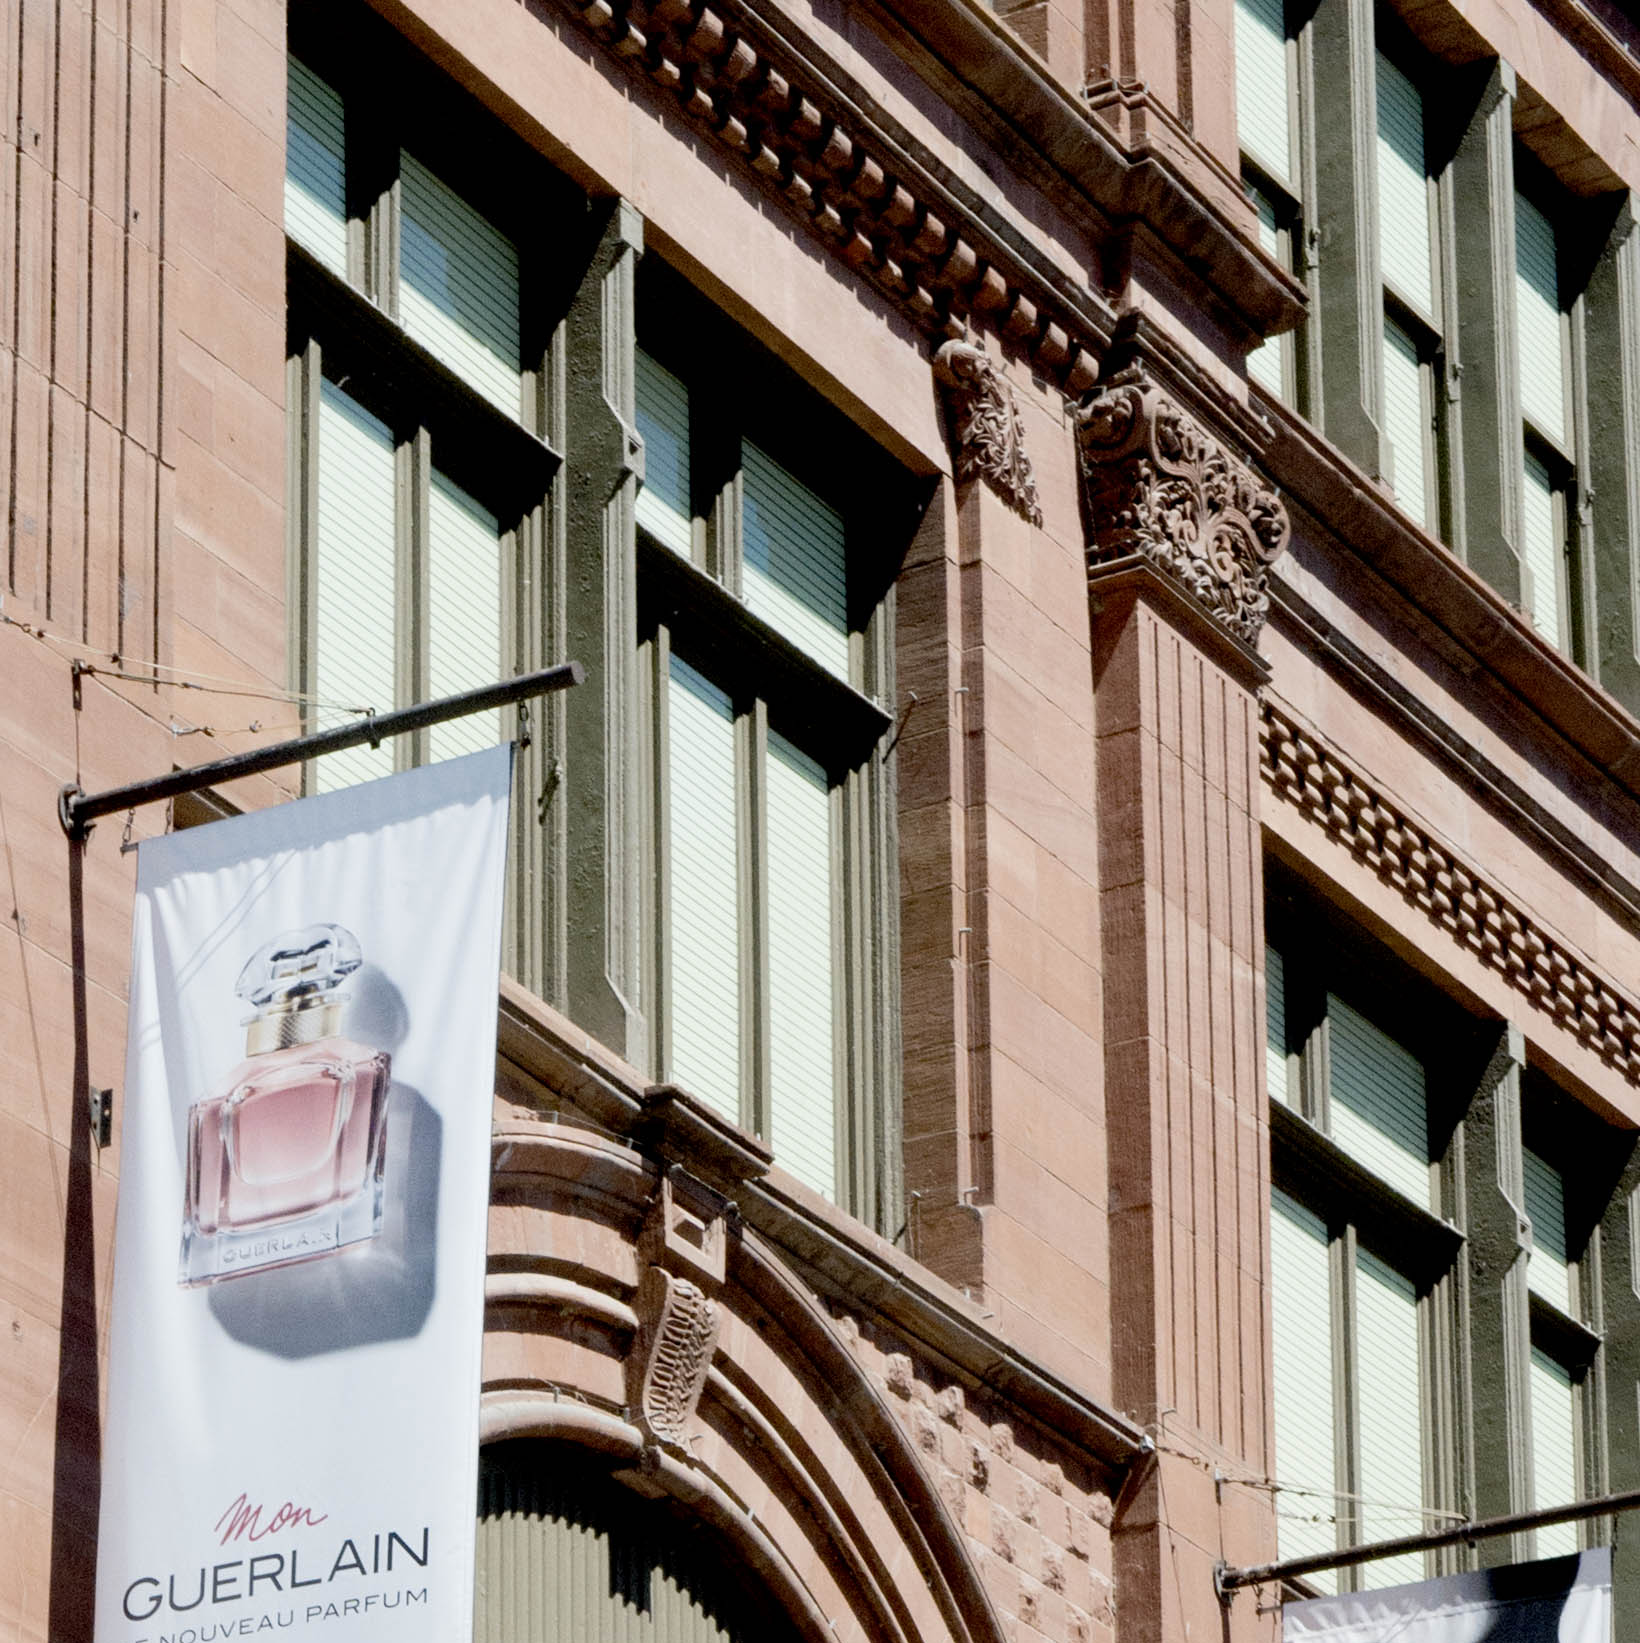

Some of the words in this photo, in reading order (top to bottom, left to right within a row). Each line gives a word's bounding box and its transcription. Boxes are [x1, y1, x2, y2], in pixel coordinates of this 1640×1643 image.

[214, 1493, 329, 1546] Mon
[122, 1527, 430, 1622] GUERLAIN
[306, 1588, 428, 1622] PARFUM
